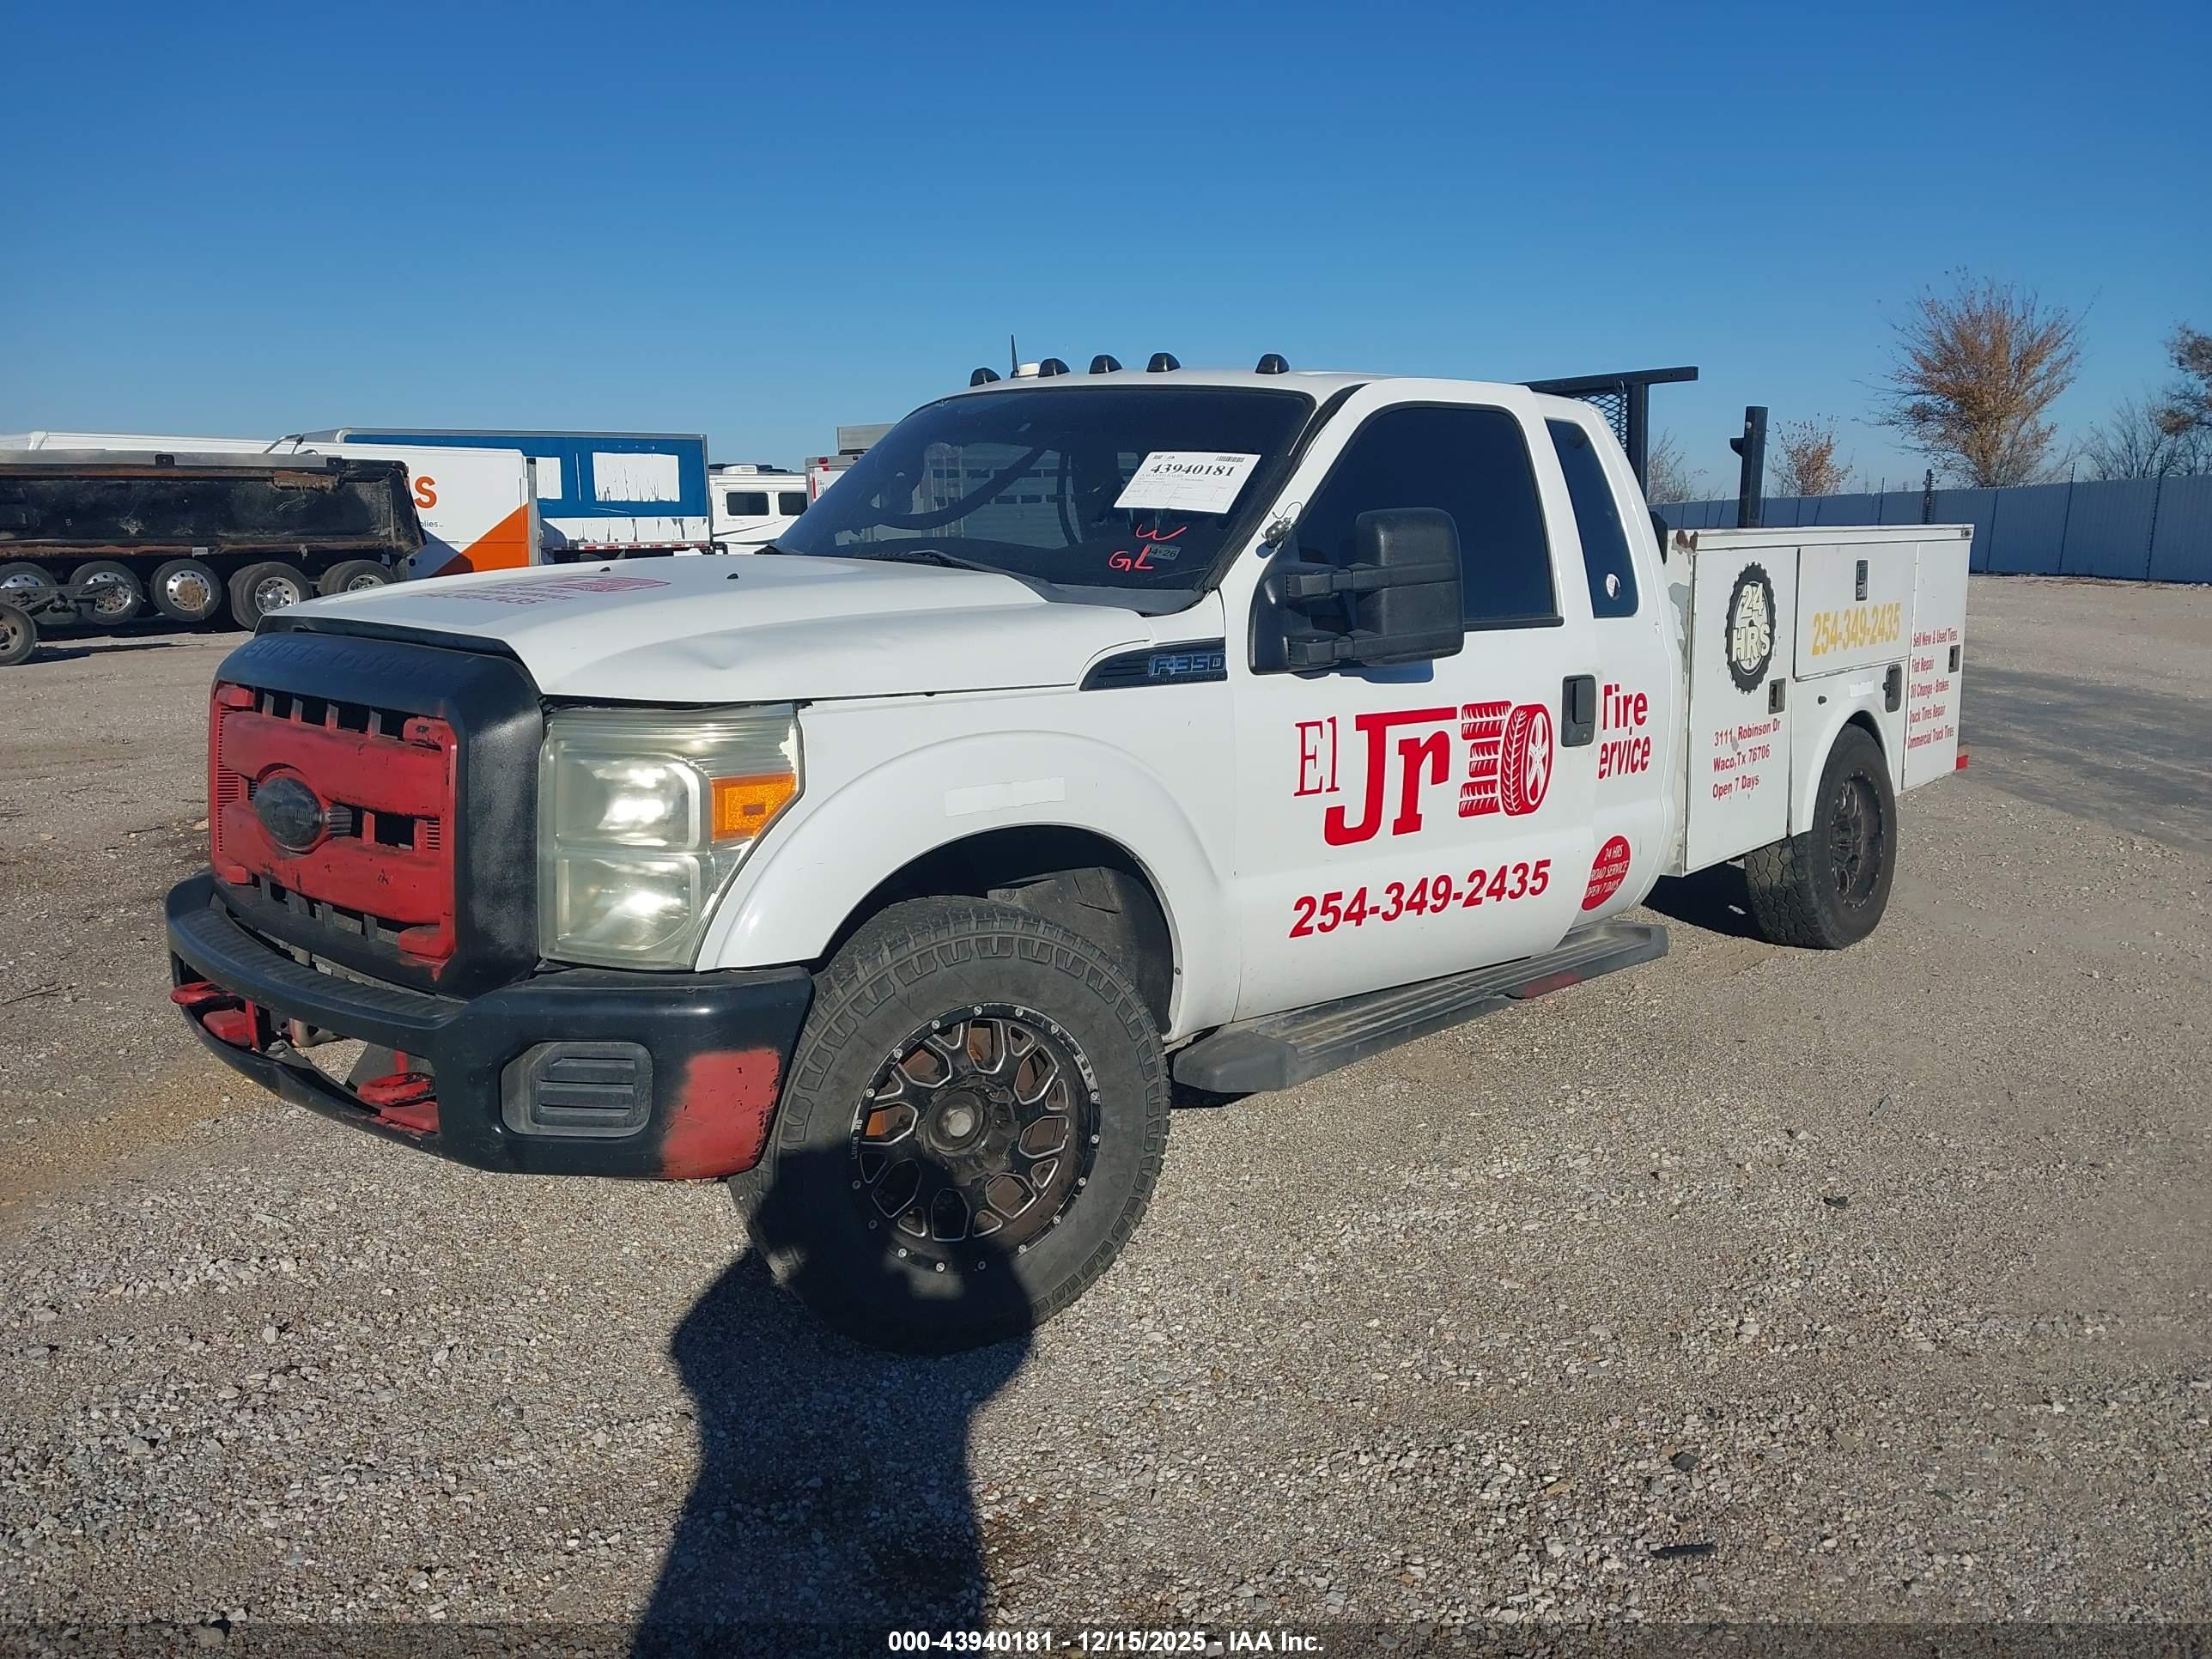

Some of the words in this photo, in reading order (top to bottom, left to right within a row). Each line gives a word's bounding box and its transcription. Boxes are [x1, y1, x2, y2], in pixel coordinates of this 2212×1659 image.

[1151, 463, 1235, 477] 43940181
[1740, 583, 1764, 619] 24
[1812, 603, 1901, 655] 254-349-2435
[1936, 629, 1948, 643] Used
[1948, 628, 1958, 641] Tires
[1732, 623, 1771, 662] HRS
[1921, 656, 1935, 674] Repair
[1917, 683, 1933, 699] Change
[1936, 678, 1950, 694] Brakes
[1922, 707, 1932, 720] Tires
[1933, 702, 1946, 720] Repair
[1714, 728, 1733, 746] 3111
[1738, 723, 1771, 740] Robinson
[1773, 718, 1781, 732] Dr
[1933, 726, 1943, 743] Truck
[1598, 726, 1650, 780] ervice
[1749, 744, 1771, 763] 76706
[1293, 715, 1340, 797] El
[1323, 706, 1458, 847] Jr
[1713, 782, 1733, 801] Open
[1735, 777, 1740, 791] 7
[1741, 775, 1759, 790] Days
[1604, 847, 1613, 861] 24
[1612, 844, 1625, 859] HRS
[1606, 860, 1629, 878] SERVICE
[1605, 878, 1621, 893] DAYS
[1289, 859, 1552, 939] 254-349-2435
